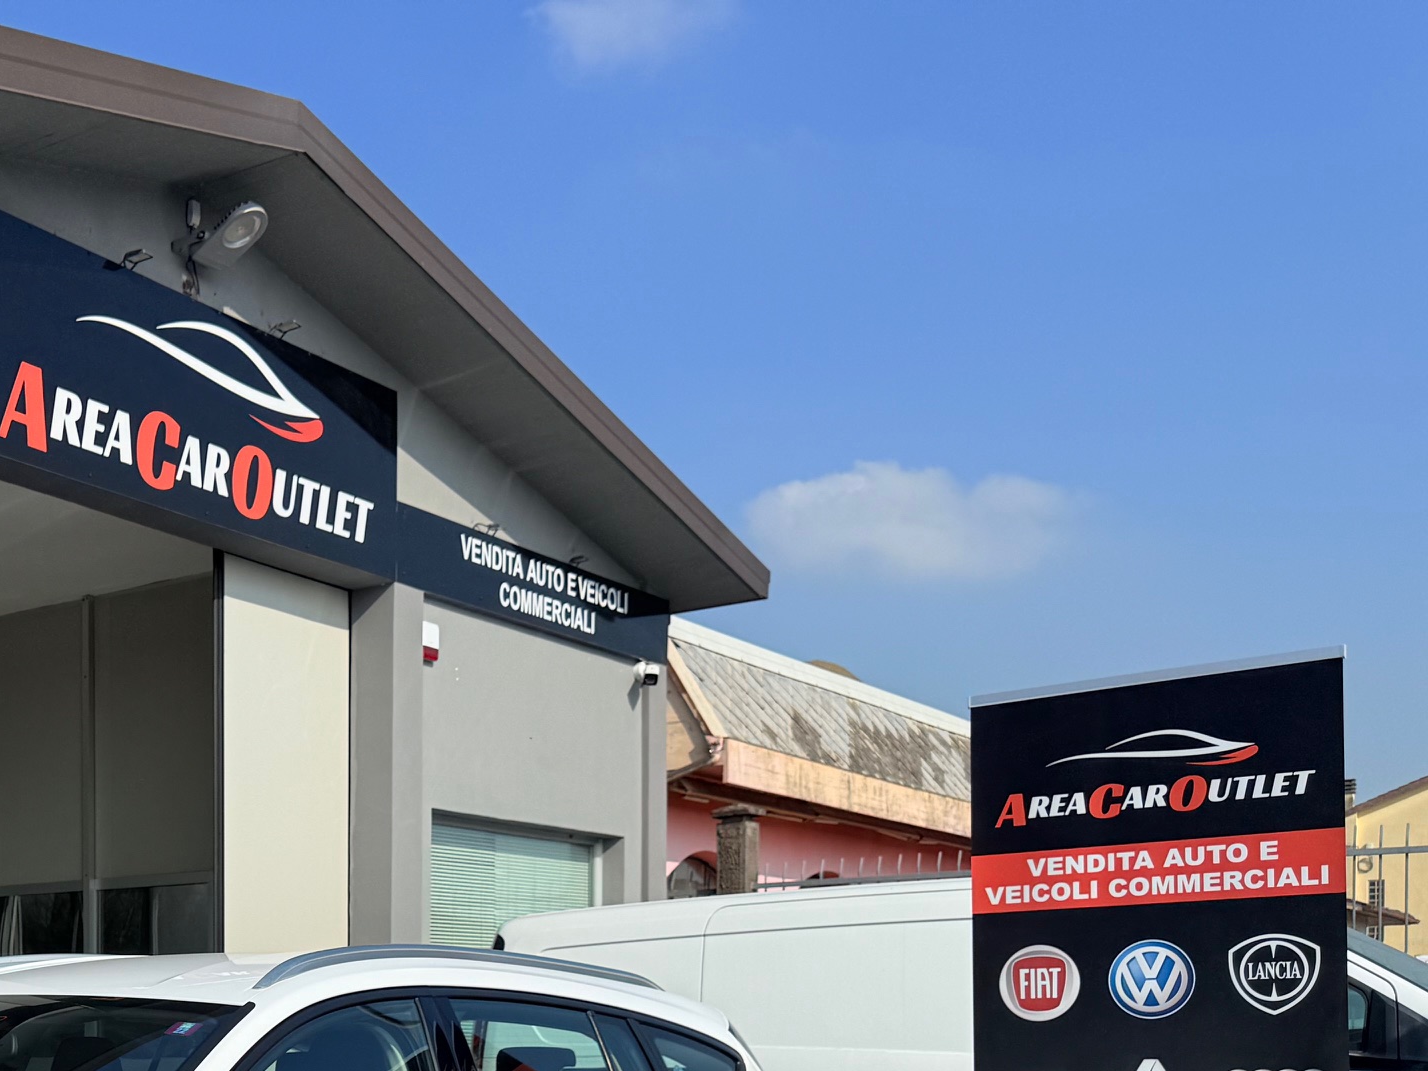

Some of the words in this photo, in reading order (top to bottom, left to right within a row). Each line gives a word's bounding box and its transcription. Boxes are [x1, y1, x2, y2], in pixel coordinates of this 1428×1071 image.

[460, 533, 524, 580] VENDITA
[526, 558, 564, 593] AUTO
[567, 572, 577, 597] E
[577, 576, 629, 615] VEICOLI
[499, 582, 596, 635] COMMERCIALI
[1027, 851, 1154, 877] VENDITA
[1163, 843, 1248, 869] AUTO
[1260, 840, 1279, 861] E
[985, 880, 1098, 906] VEICOLI
[1108, 865, 1330, 898] COMMERCIALI
[1018, 966, 1062, 1000] FIAT
[1246, 960, 1303, 981] LANCIA
